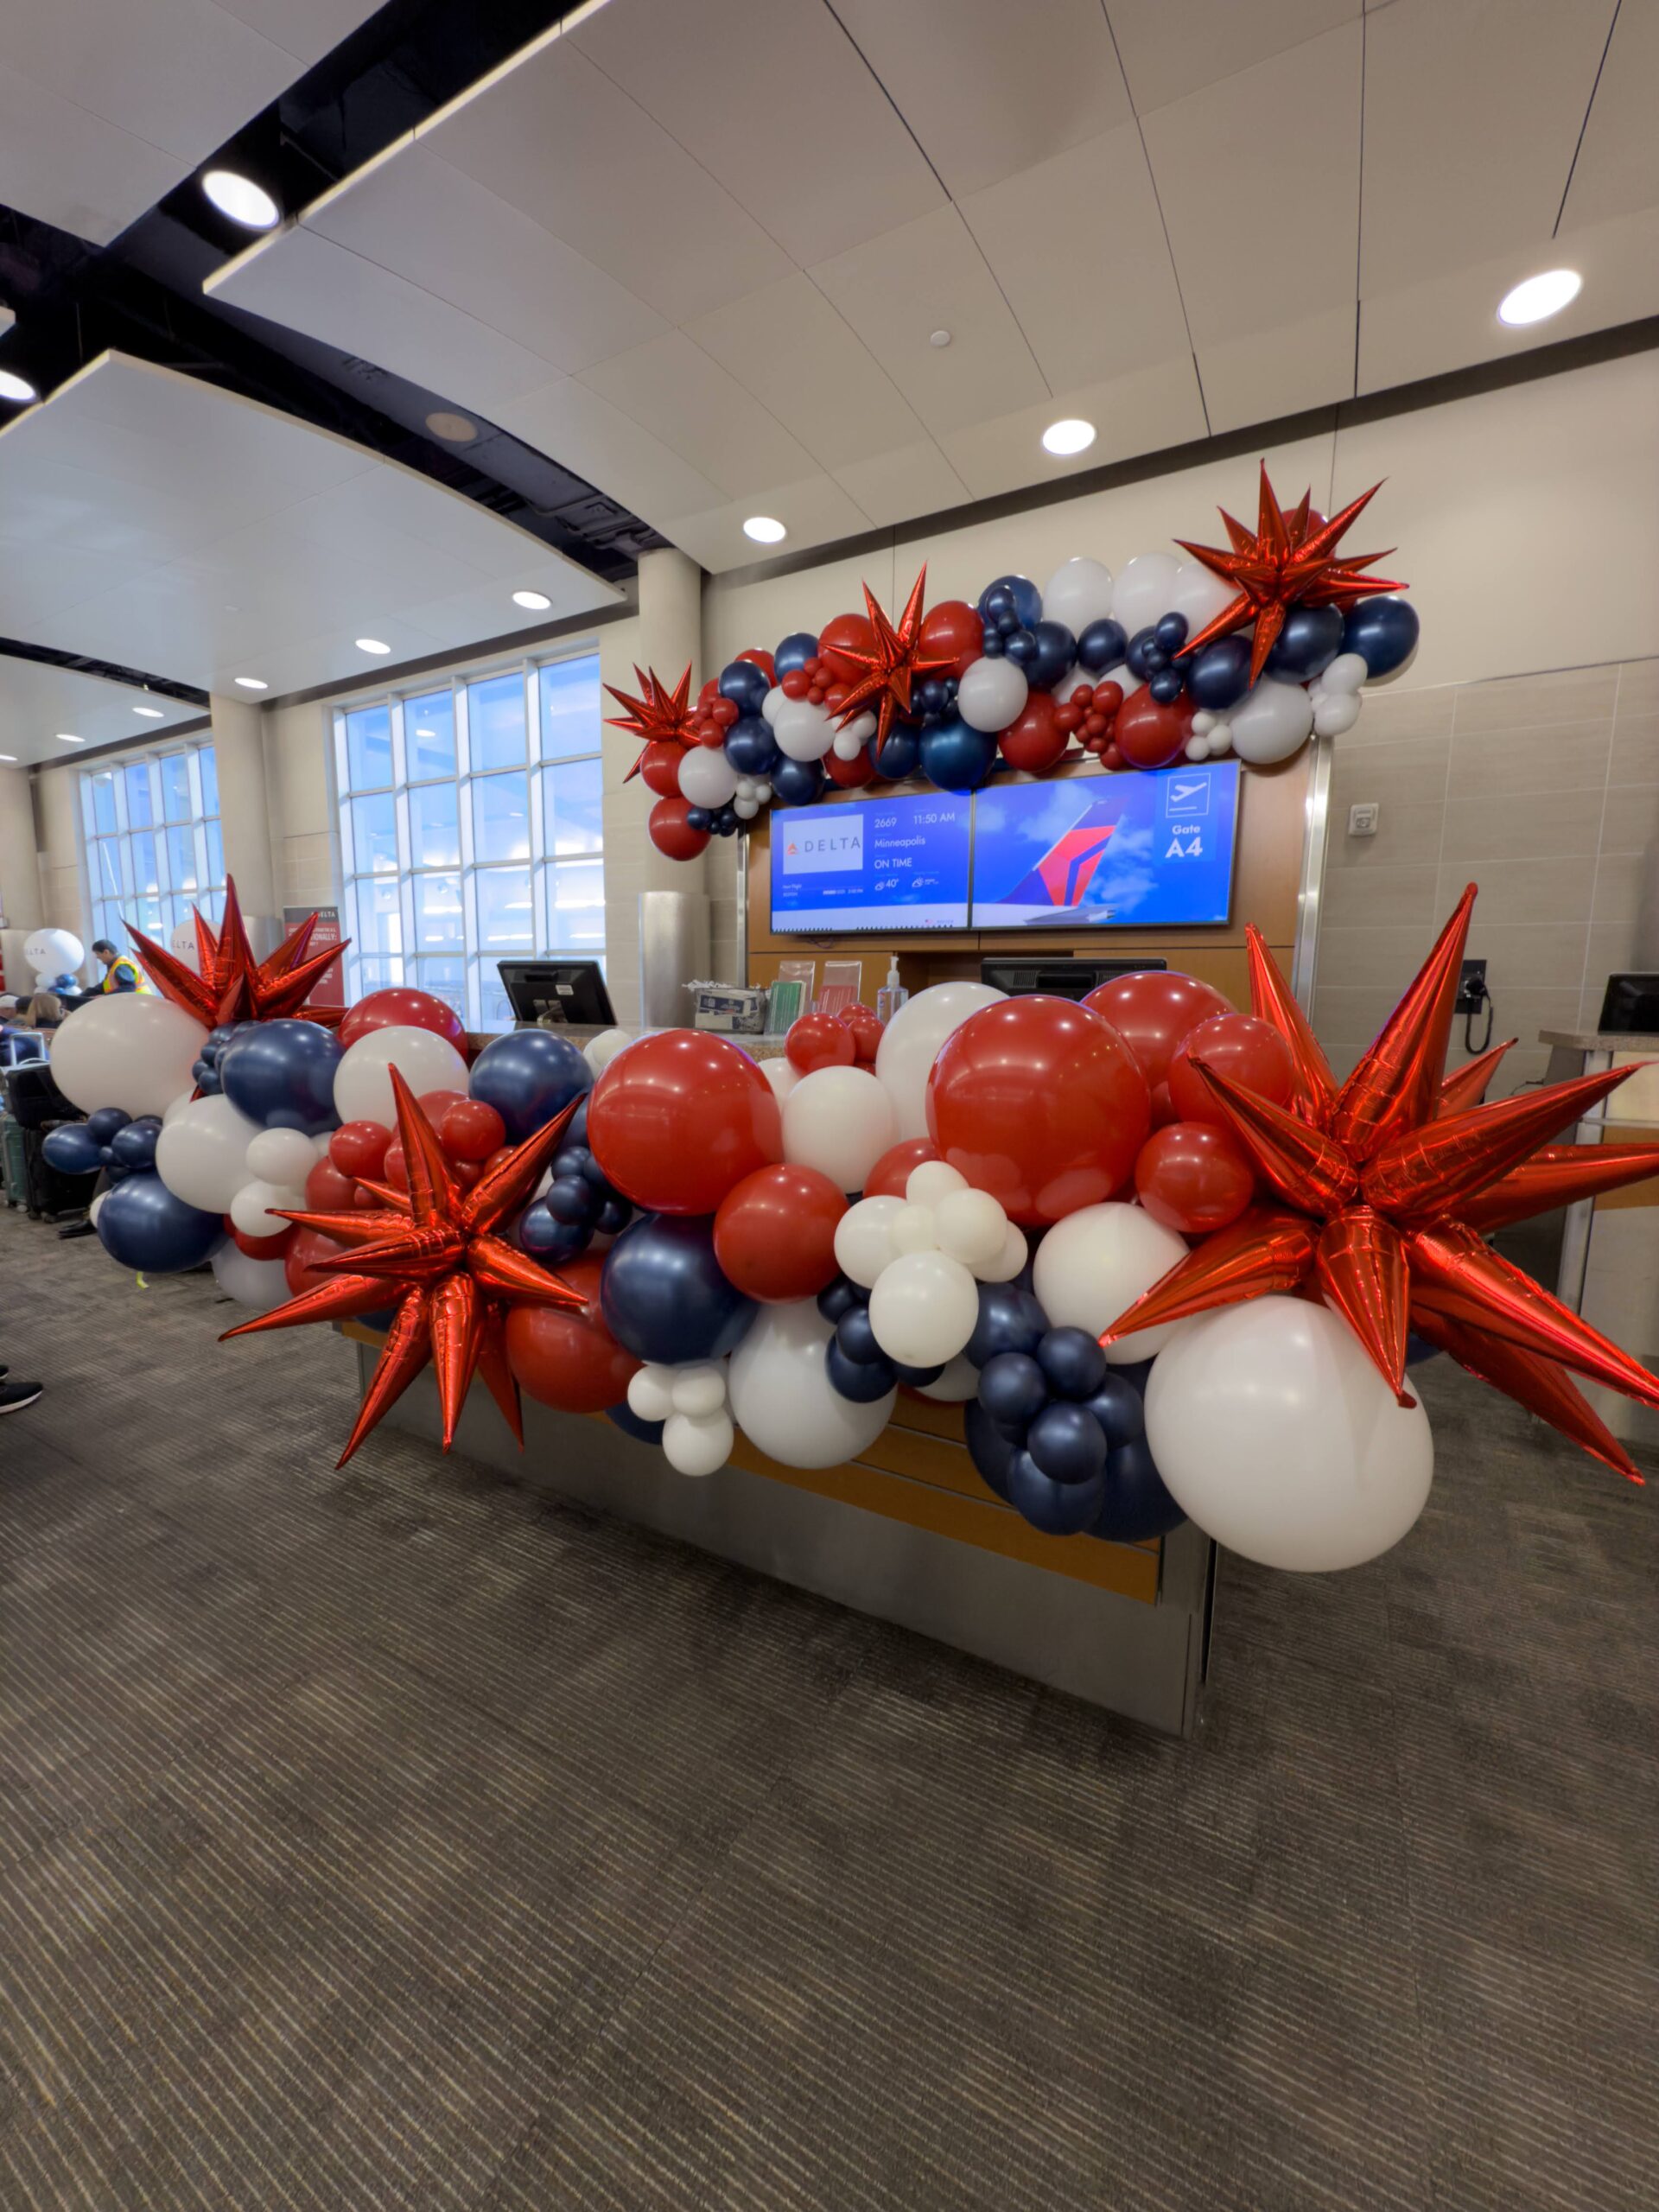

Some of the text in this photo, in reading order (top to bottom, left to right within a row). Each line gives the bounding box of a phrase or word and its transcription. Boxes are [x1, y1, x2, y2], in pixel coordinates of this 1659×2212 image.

[874, 817, 897, 829] 2669
[913, 813, 956, 824] 11:50 AM
[1172, 824, 1201, 835] Gate
[804, 836, 861, 853] DELTA
[874, 836, 926, 849] Minneapolis
[1165, 836, 1204, 858] A4
[874, 857, 912, 869] ON TIME
